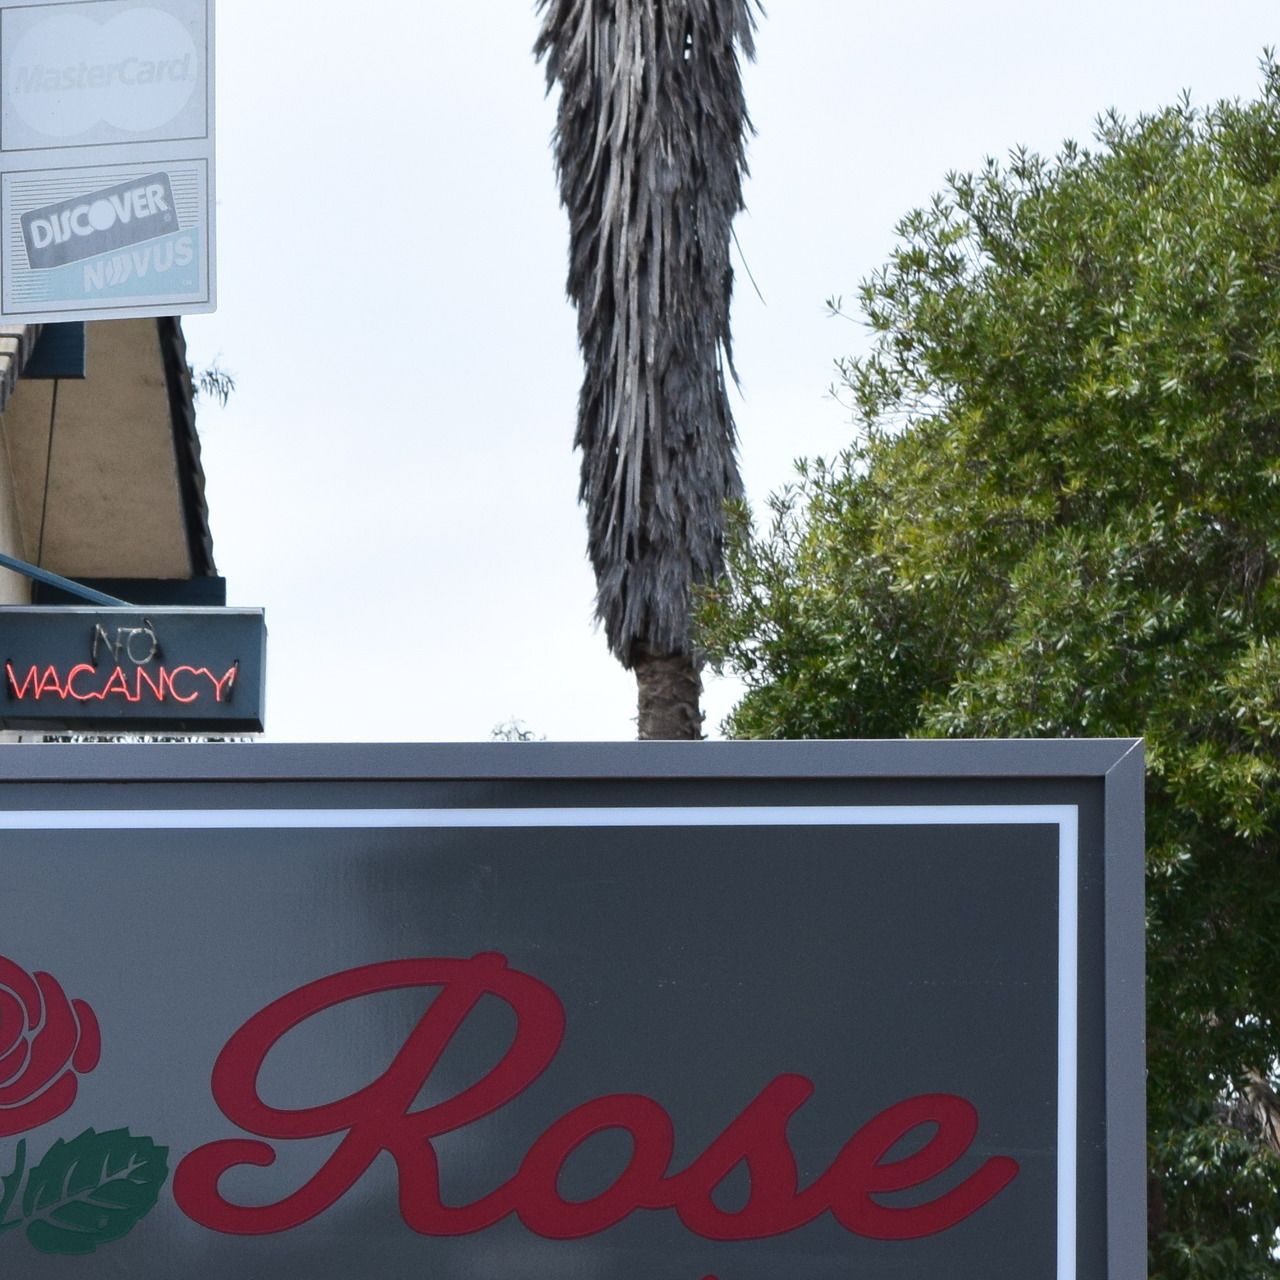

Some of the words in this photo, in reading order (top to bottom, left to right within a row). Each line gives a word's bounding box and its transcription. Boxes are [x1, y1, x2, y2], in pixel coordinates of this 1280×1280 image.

[14, 53, 192, 94] MasterCard
[30, 184, 169, 249] DISCOVER
[83, 236, 194, 293] NOVUS
[92, 623, 158, 665] NO
[6, 663, 237, 702] VACANCY
[173, 950, 1020, 1240] Rose
